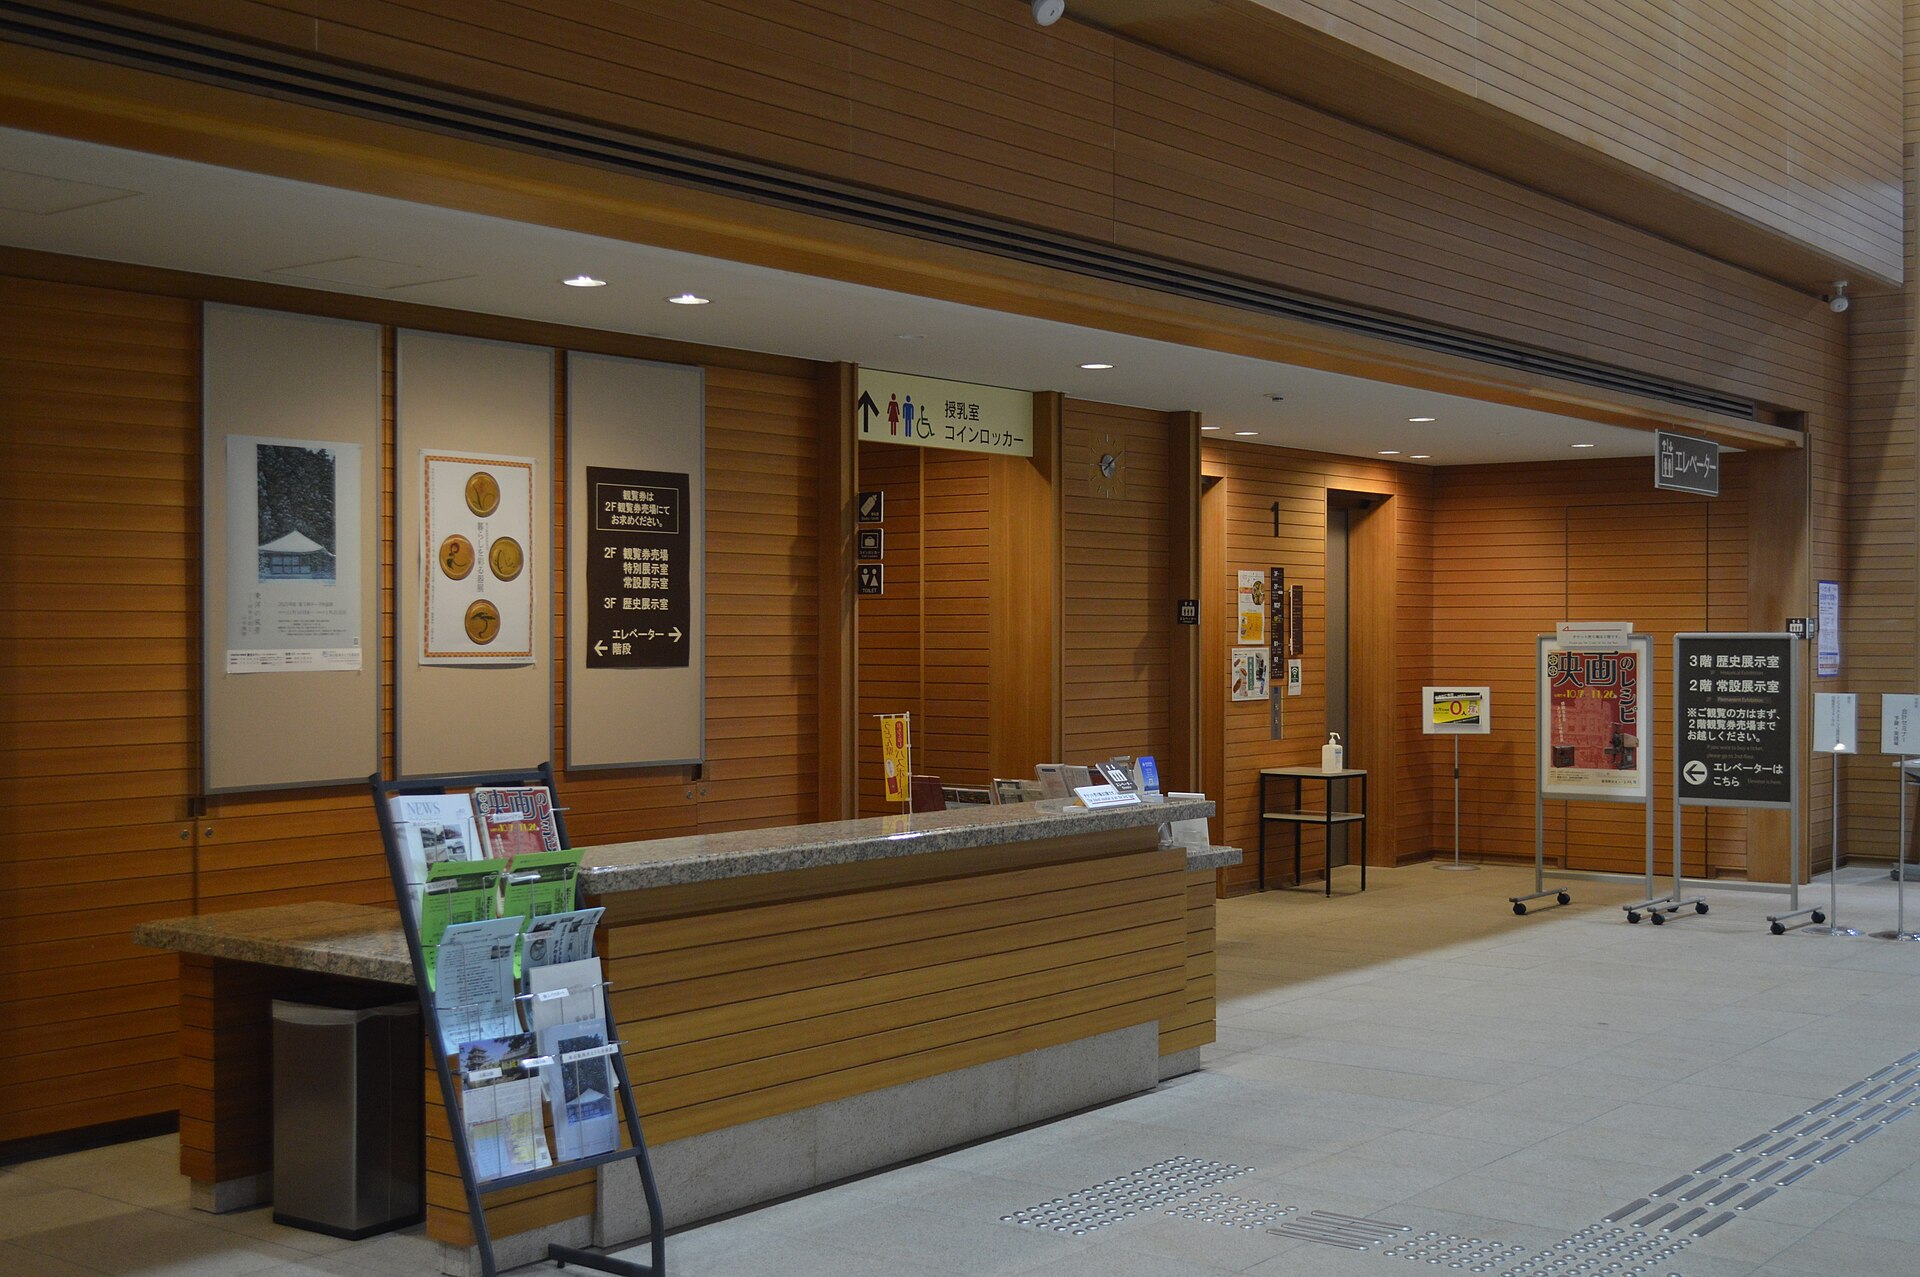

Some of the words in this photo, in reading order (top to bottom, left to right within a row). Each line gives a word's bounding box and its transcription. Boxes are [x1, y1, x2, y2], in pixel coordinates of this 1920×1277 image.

[945, 400, 980, 421] 授乳室
[945, 426, 1024, 447] コインロッカー
[1675, 451, 1717, 478] エレベーター
[623, 490, 654, 502] 観覧券は
[611, 515, 663, 527] お求めください。
[604, 547, 617, 558] 2F
[623, 548, 669, 561] 観覧券売場
[623, 562, 669, 575] 特別展示室
[623, 577, 669, 590] 常設展示室
[604, 597, 617, 609] 3F
[623, 598, 669, 610] 歴史展示室
[612, 628, 664, 640] エレベーター
[612, 643, 632, 655] 階段
[1689, 655, 1712, 668] 3階
[1716, 655, 1780, 668] 歴史展示室
[1553, 650, 1619, 688] 映画
[1619, 656, 1639, 724] のレシピ
[1689, 680, 1712, 693] 2階
[1716, 680, 1780, 693] 常設展示室
[1687, 708, 1781, 720] ※ご観覧の方はまず、
[1688, 719, 1776, 731] 2階観覧券売場まで
[1687, 731, 1761, 742] お越しください。
[1713, 763, 1783, 775] エレベーターは
[1713, 776, 1740, 786] こちら
[407, 800, 441, 815] NEWS
